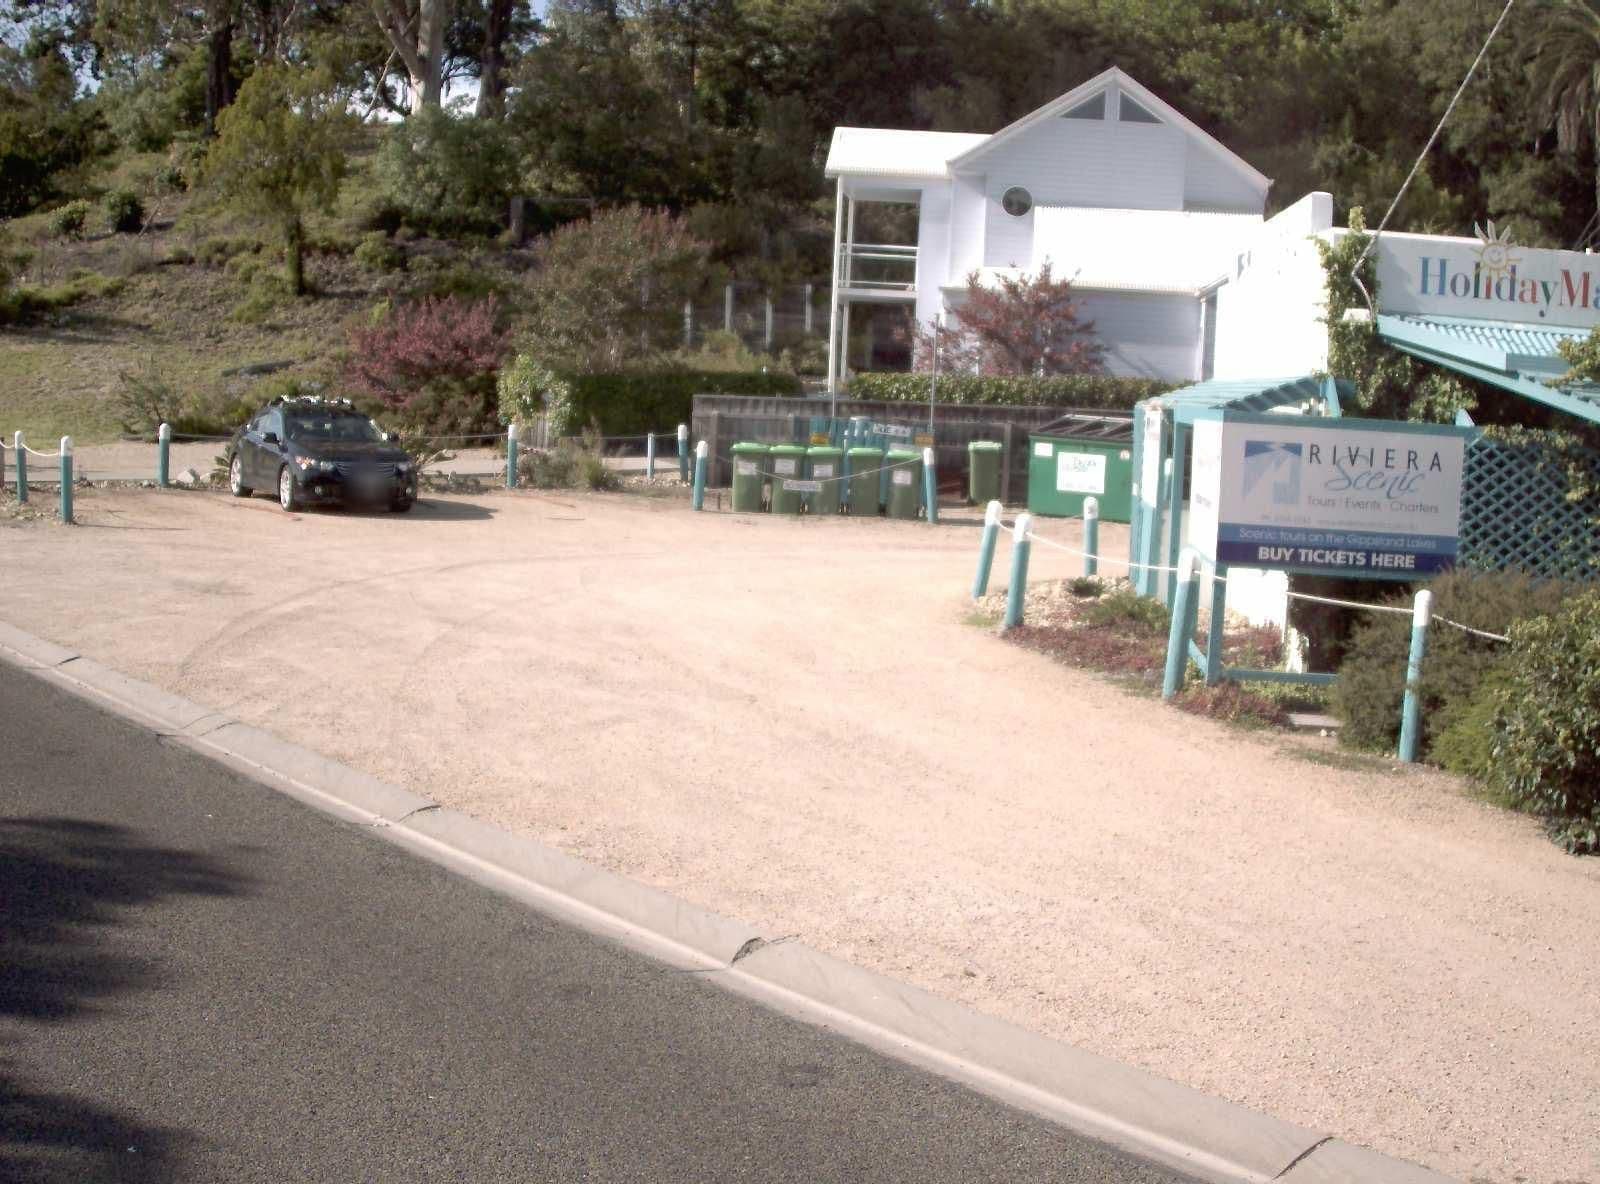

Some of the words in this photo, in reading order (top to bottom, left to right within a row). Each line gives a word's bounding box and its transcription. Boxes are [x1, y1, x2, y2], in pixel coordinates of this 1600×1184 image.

[1309, 443, 1442, 472] RIVIERA
[1324, 455, 1425, 499] Scenic
[1308, 495, 1336, 508] Tours
[1345, 498, 1381, 511] Events
[1390, 502, 1439, 514] Charters
[1239, 528, 1279, 540] Scenic
[1308, 534, 1325, 544] on
[1326, 533, 1345, 545] the
[1407, 537, 1437, 549] Lakes
[1258, 546, 1294, 562] BUY
[1299, 549, 1367, 566] TICKETS
[1372, 553, 1416, 568] HERE
